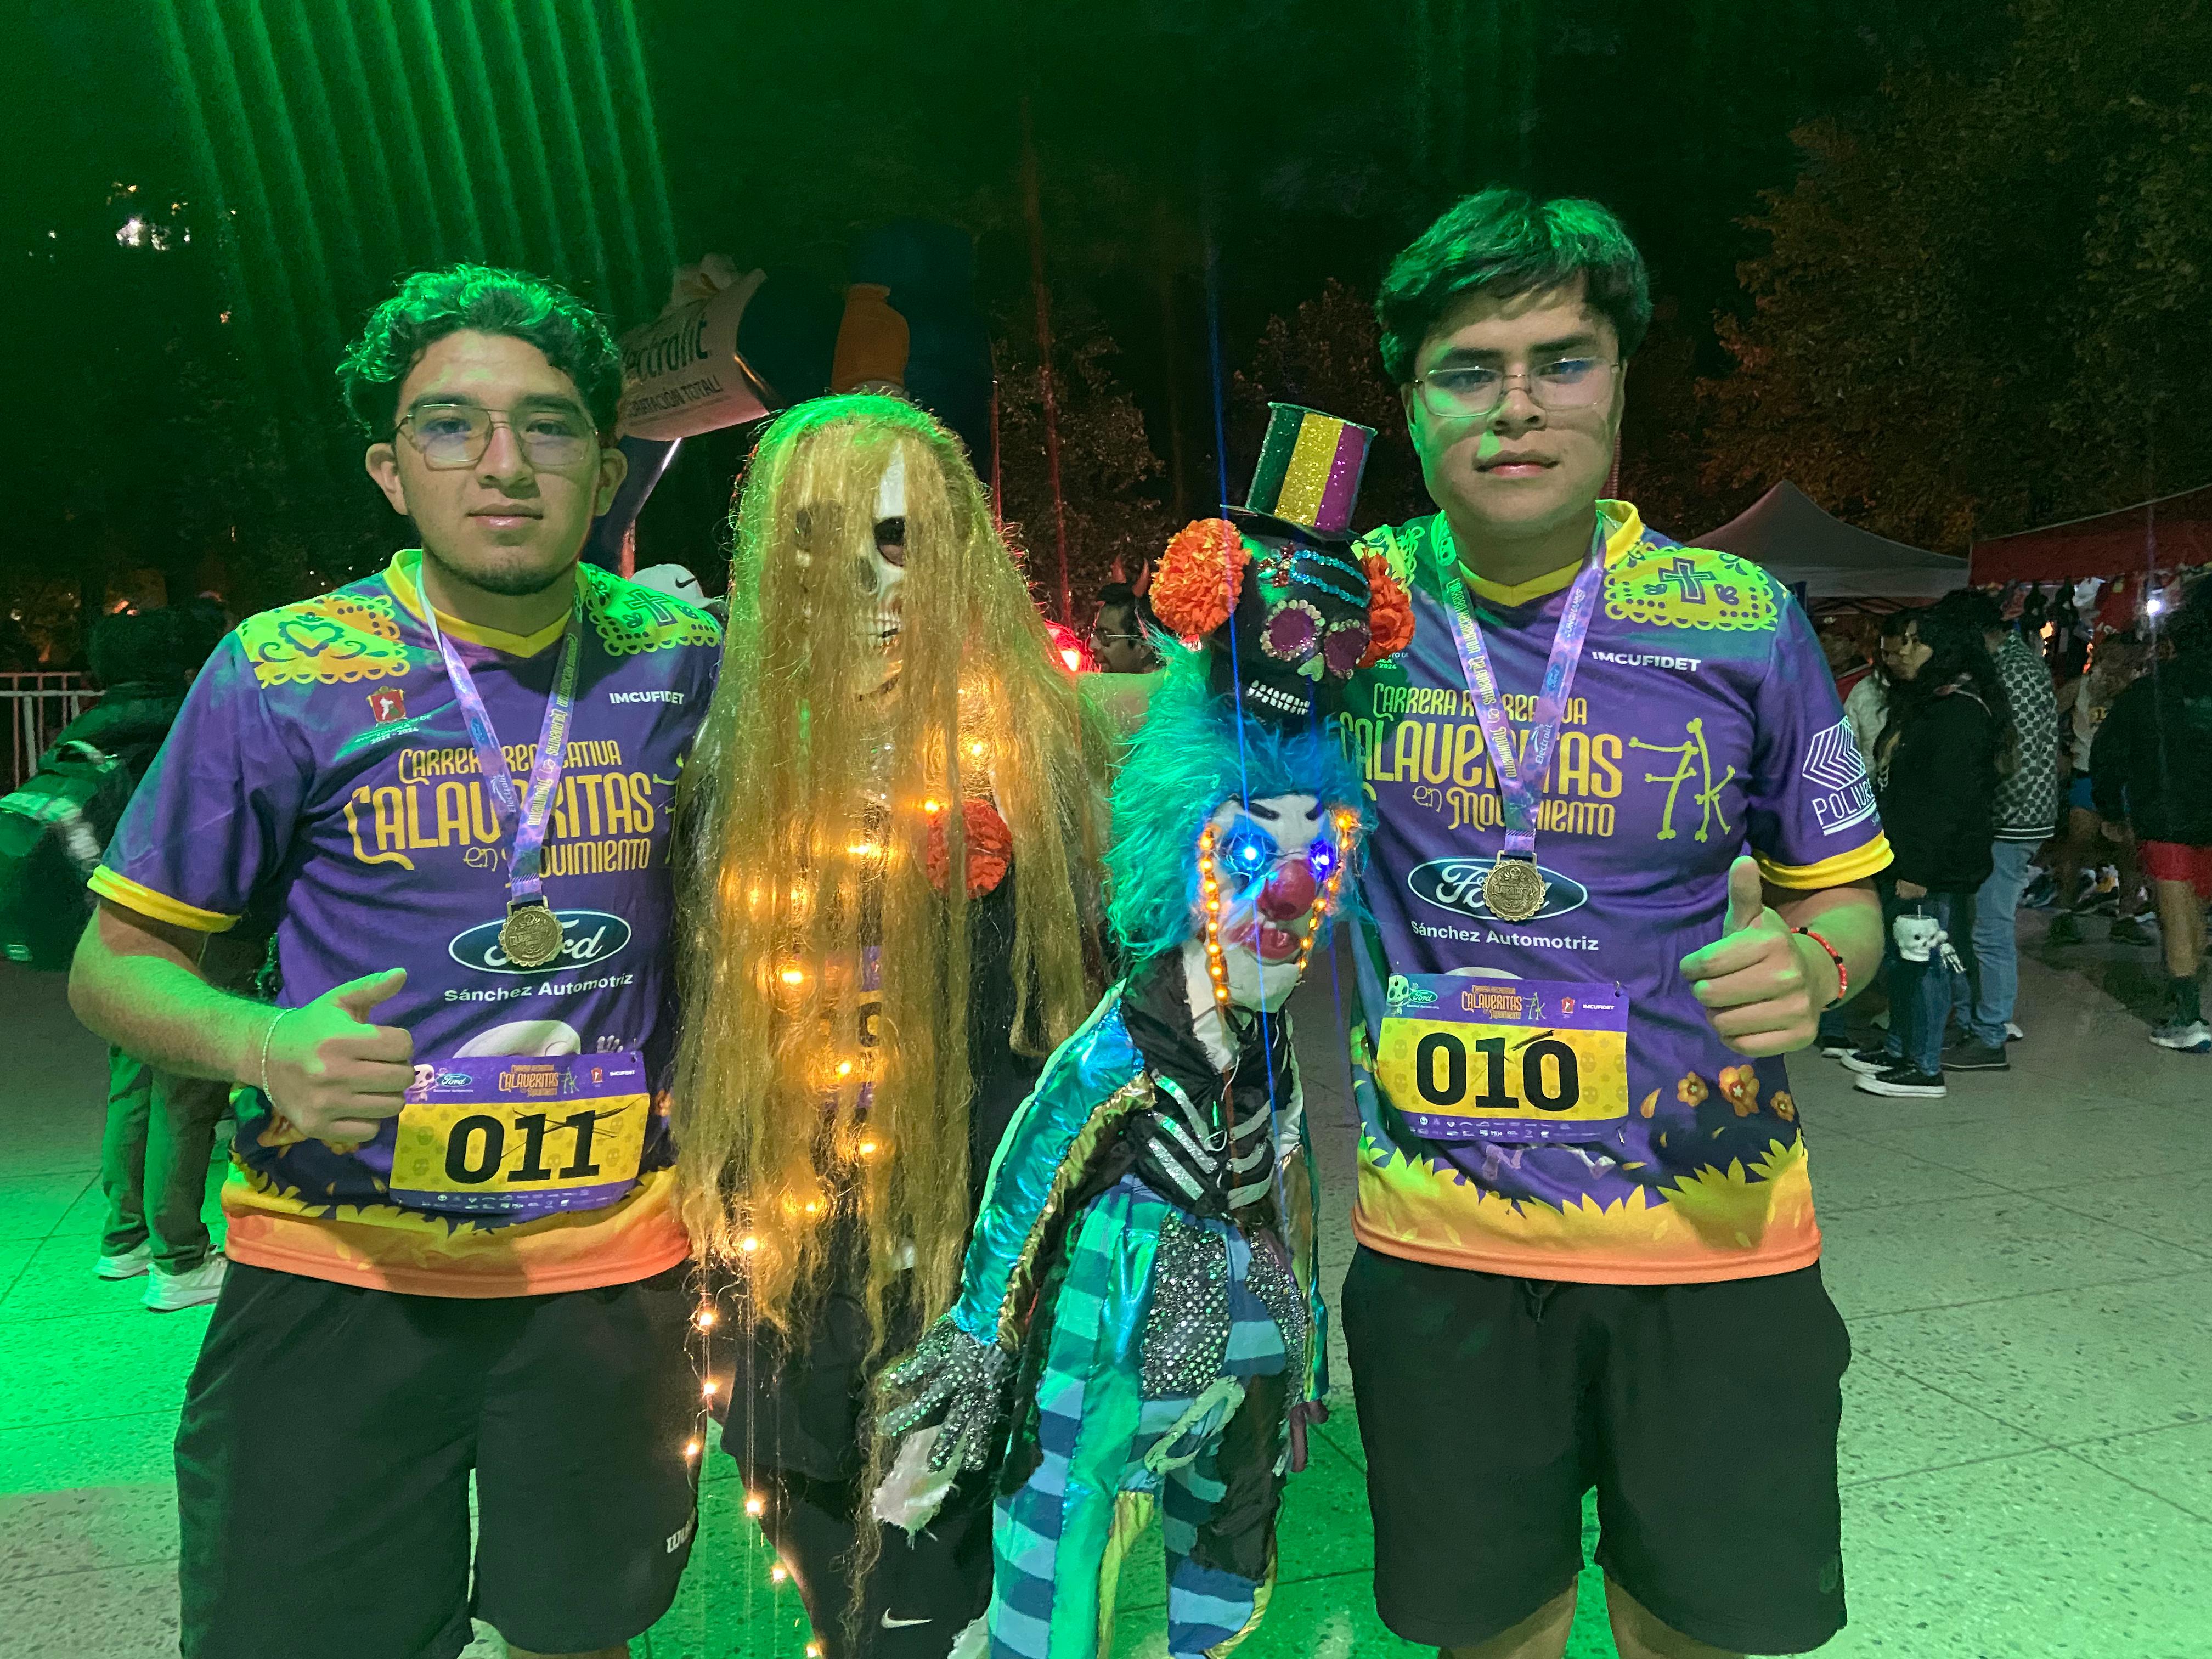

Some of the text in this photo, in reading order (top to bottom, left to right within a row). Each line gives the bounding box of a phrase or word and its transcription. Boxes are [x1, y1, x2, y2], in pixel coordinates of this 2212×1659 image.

[1592, 651, 1702, 672] IMCUFIDET
[609, 691, 684, 704] IMCUFIDET
[1373, 682, 1457, 721] CARRERA
[398, 747, 482, 786] CARRER
[1410, 921, 1599, 951] Sánchez Automotriz
[444, 986, 532, 1002] Sánchez
[1412, 991, 1432, 1002] Ford
[1462, 991, 1523, 1013] CALAVERITAS
[441, 1075, 466, 1086] Ford
[498, 1071, 560, 1093] CALAVERITAS
[1417, 1032, 1580, 1111] 010
[445, 1110, 600, 1184] 011
